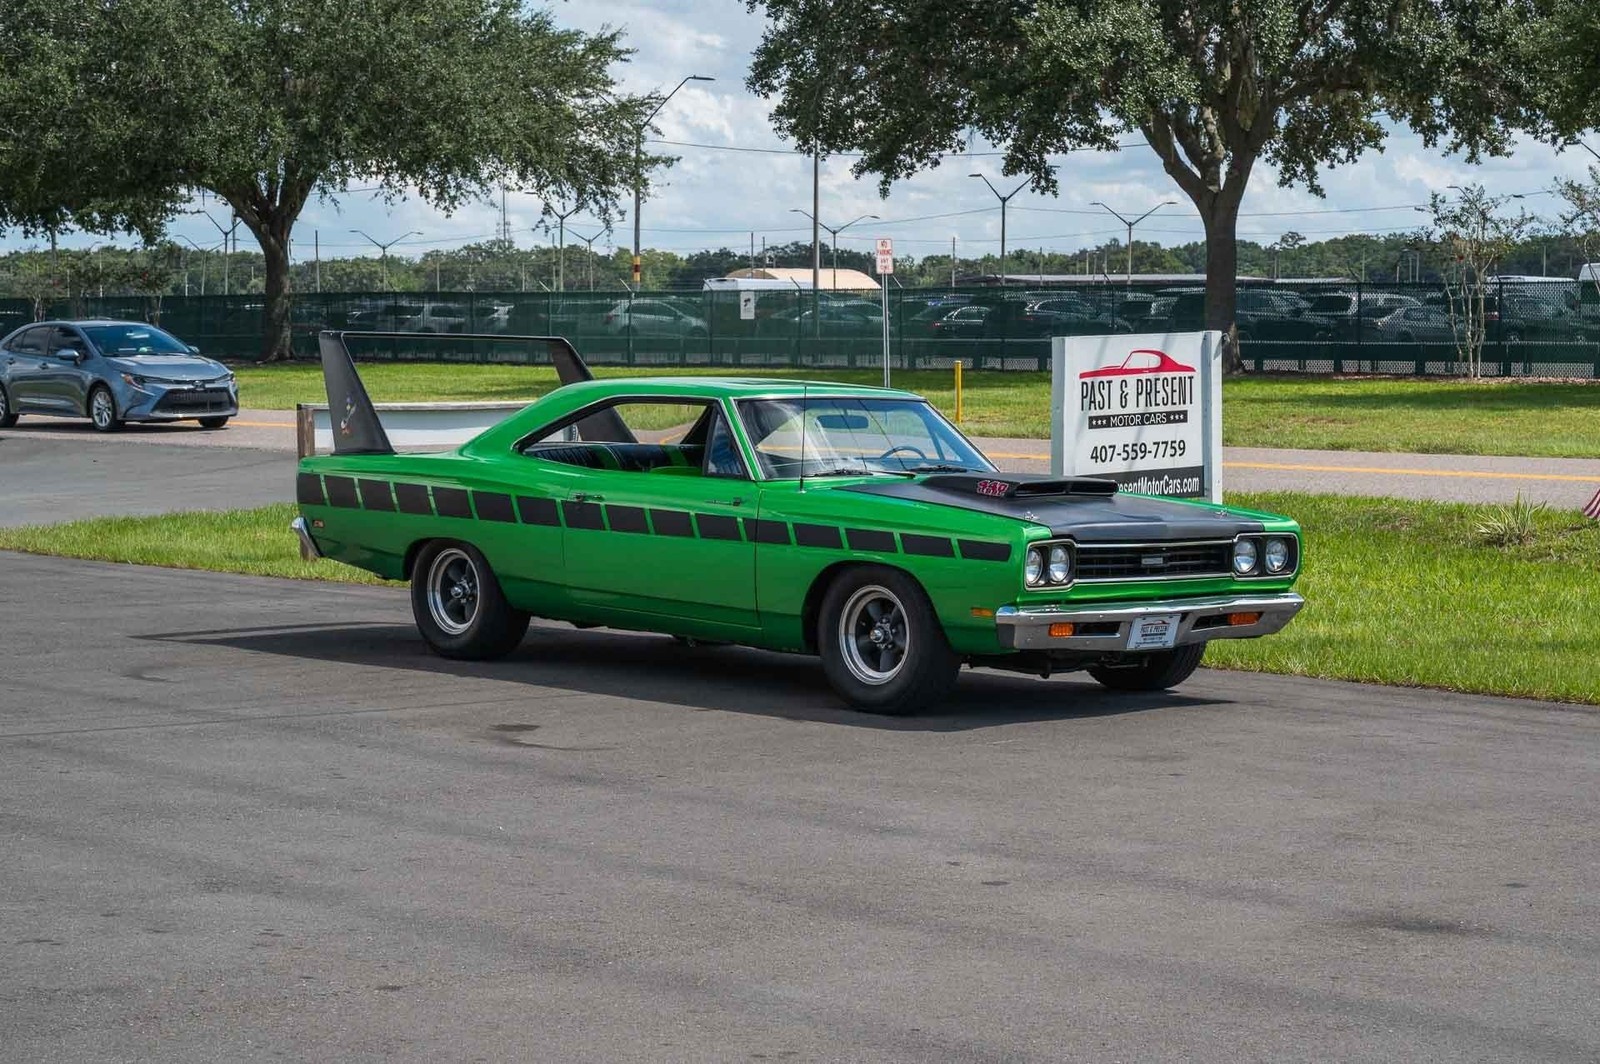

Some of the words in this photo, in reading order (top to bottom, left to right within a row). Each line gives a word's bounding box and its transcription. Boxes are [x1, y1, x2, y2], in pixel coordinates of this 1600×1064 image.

[1080, 380, 1113, 411] PAST
[1120, 379, 1129, 409] &
[1136, 376, 1194, 408] PRESENT
[1110, 414, 1142, 428] MOTOR
[1143, 413, 1167, 425] CARS
[1090, 439, 1186, 463] 407-559-7759
